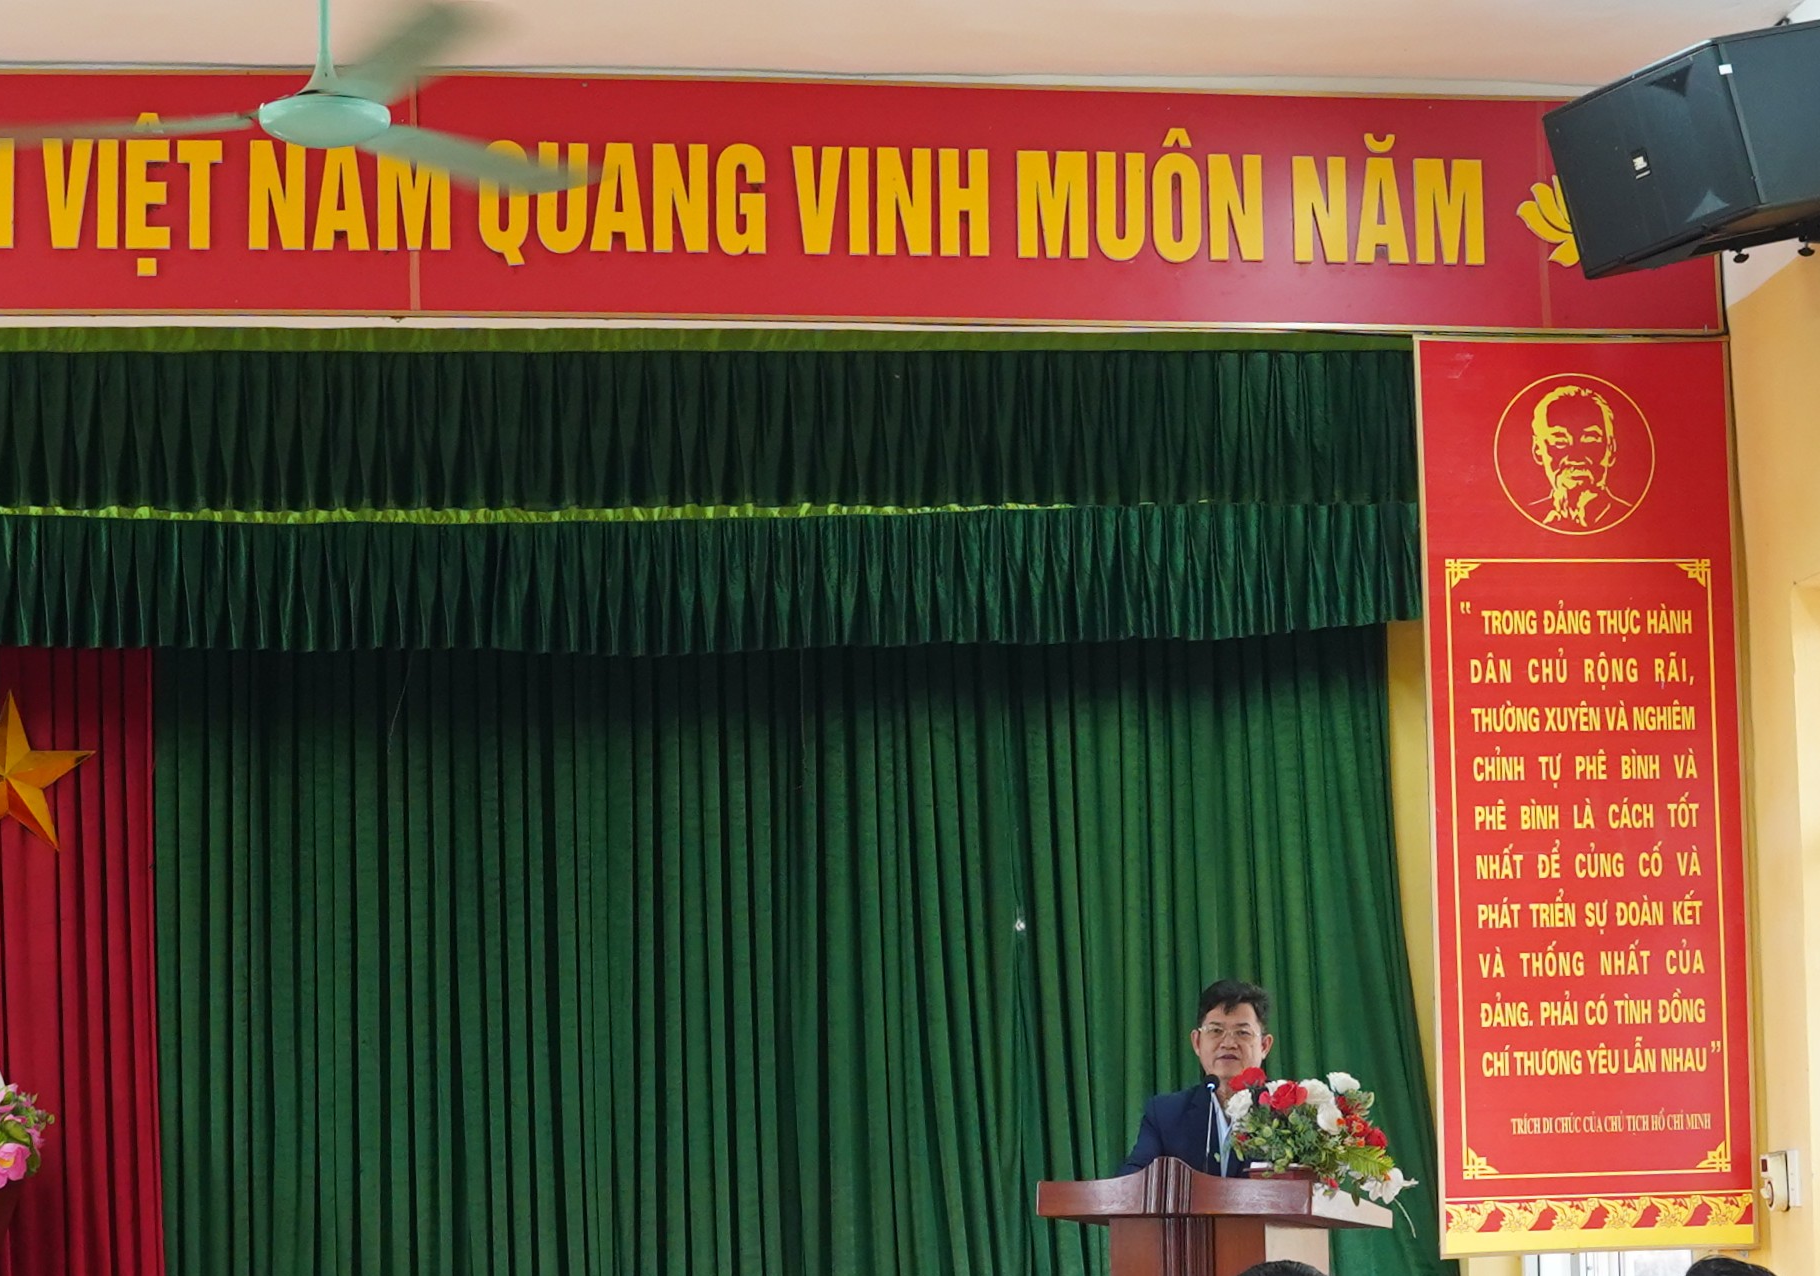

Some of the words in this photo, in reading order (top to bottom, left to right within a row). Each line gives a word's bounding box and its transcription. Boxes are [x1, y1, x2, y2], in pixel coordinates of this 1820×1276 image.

[39, 112, 223, 277] VIỆT
[248, 140, 451, 251] NAM
[478, 140, 767, 266] QUANG
[792, 145, 989, 259] VINH
[1017, 127, 1264, 264] MUÔN
[1293, 131, 1486, 268] NĂM
[1481, 610, 1537, 634] TRONG
[1543, 600, 1591, 634] ĐẢNG
[1597, 608, 1640, 642] THỰC
[1647, 604, 1692, 634] HÀNH
[1470, 652, 1511, 683] DÂN
[1528, 648, 1567, 683] CHỦ
[1584, 652, 1638, 690] RỘNG
[1655, 652, 1694, 687] RÃI,
[1471, 701, 1540, 732] THƯỜNG
[1545, 701, 1600, 731] XUYÊN
[1605, 700, 1628, 731] VÀ
[1633, 700, 1695, 730] NGHIÊM
[1473, 746, 1524, 781] CHỈNH
[1538, 753, 1561, 788] TỰ
[1575, 749, 1607, 779] PHÊ
[1621, 749, 1660, 779] BÌNH
[1674, 748, 1698, 778] VÀ
[1475, 799, 1506, 830] PHÊ
[1521, 799, 1559, 829] BÌNH
[1573, 798, 1595, 829] LÀ
[1608, 798, 1654, 828] CÁCH
[1667, 792, 1699, 828] TỐT
[1476, 844, 1523, 879] NHẤT
[1538, 840, 1560, 878] ĐỂ
[1575, 843, 1624, 878] CỦNG
[1639, 841, 1662, 877] CỐ
[1677, 845, 1701, 876] VÀ
[1478, 897, 1521, 928] PHÁT
[1529, 889, 1576, 927] TRIỂN
[1585, 900, 1608, 934] SỰ
[1616, 895, 1663, 926] ĐOÀN
[1673, 890, 1702, 925] KẾT
[1479, 947, 1505, 978] VÀ
[1520, 941, 1584, 977] THỐNG
[1600, 940, 1650, 975] NHẤT
[1666, 939, 1704, 974] CỦA
[1480, 992, 1533, 1027] ĐẢNG.
[1540, 991, 1578, 1026] PHẢI
[1585, 994, 1608, 1025] CÓ
[1614, 994, 1652, 1024] TÌNH
[1658, 988, 1705, 1023] ĐỒNG
[1482, 1045, 1509, 1077] CHÍ
[1513, 1048, 1582, 1075] THƯƠNG
[1587, 1043, 1619, 1074] YÊU
[1624, 1036, 1656, 1073] LẪN
[1511, 1113, 1540, 1134] TRÍCH
[1543, 1117, 1553, 1133] DI
[1555, 1112, 1581, 1133] CHÚC
[1604, 1110, 1624, 1132] CHỦ
[1626, 1114, 1649, 1135] TỊCH
[1652, 1107, 1665, 1131] HỒ
[1667, 1109, 1684, 1130] CHÍ
[1686, 1113, 1711, 1129] MINH
